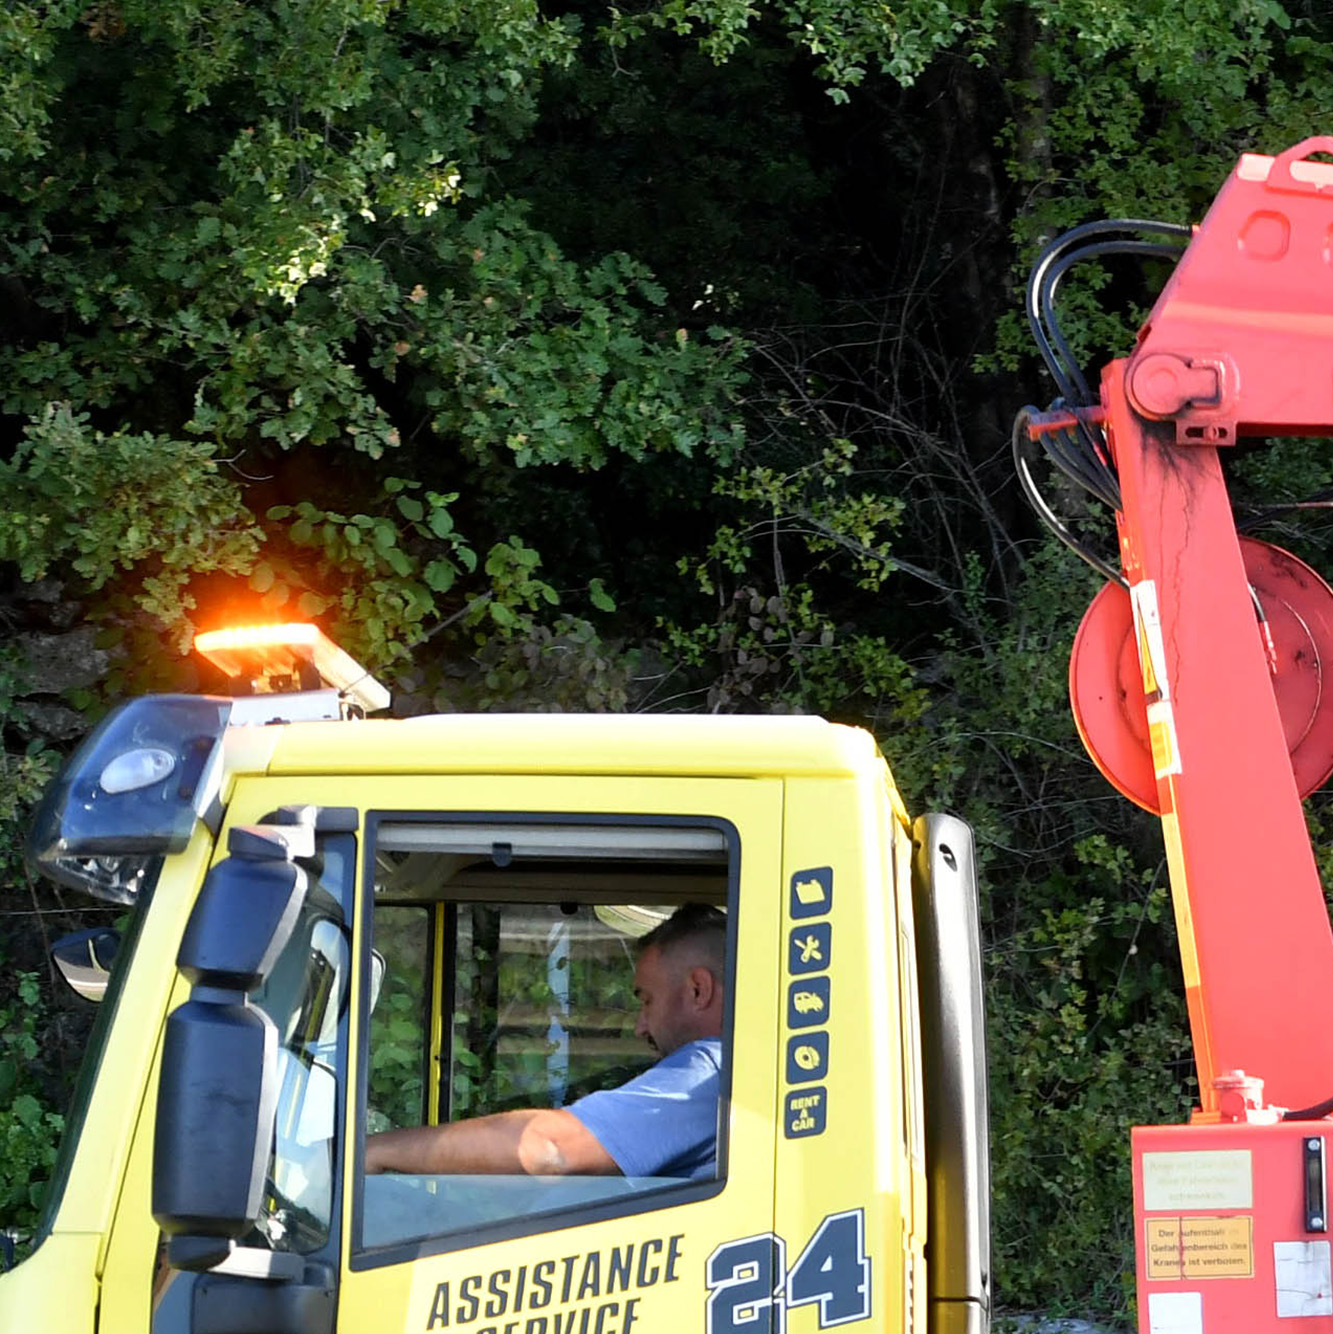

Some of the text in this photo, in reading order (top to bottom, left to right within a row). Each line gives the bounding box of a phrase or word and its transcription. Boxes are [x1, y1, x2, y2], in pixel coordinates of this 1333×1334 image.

[790, 1094, 820, 1111] RENT
[799, 1107, 809, 1119] A
[791, 1116, 815, 1132] CAR
[426, 1233, 686, 1331] ASSISTANCE
